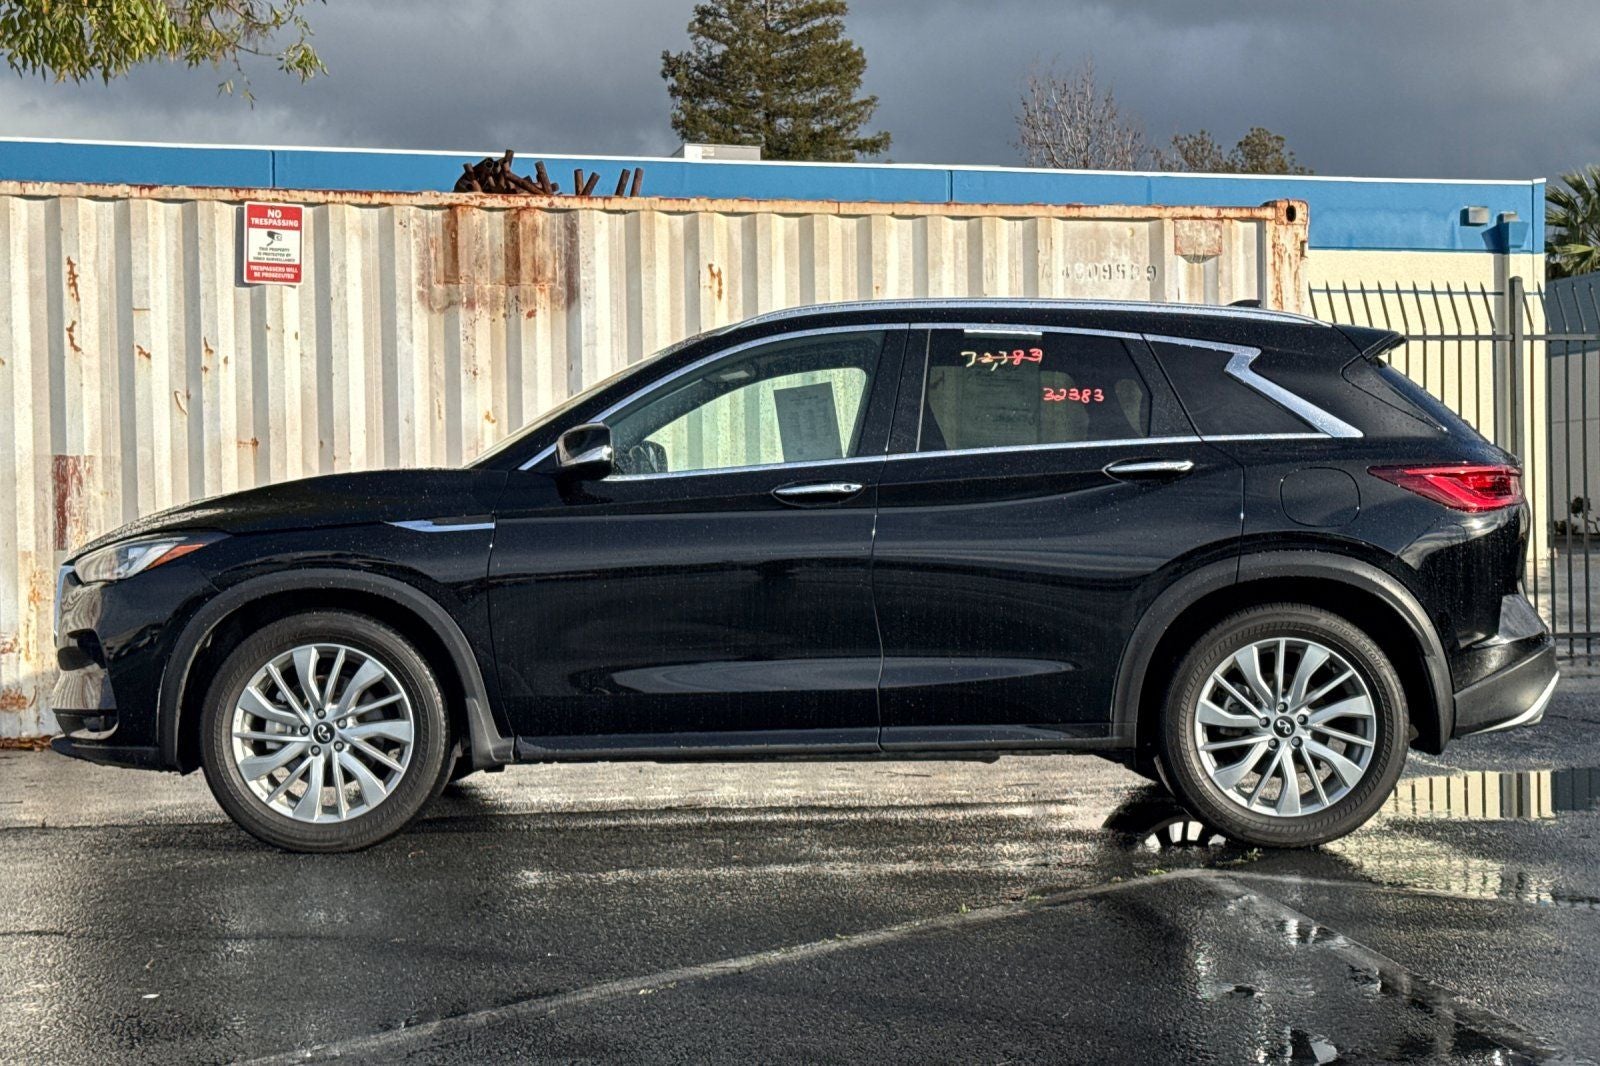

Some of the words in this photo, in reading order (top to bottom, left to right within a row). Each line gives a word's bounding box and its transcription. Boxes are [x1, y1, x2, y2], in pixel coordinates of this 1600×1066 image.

[267, 209, 282, 218] NO
[250, 217, 299, 227] TRESPASSING
[1043, 387, 1104, 403] 32383
